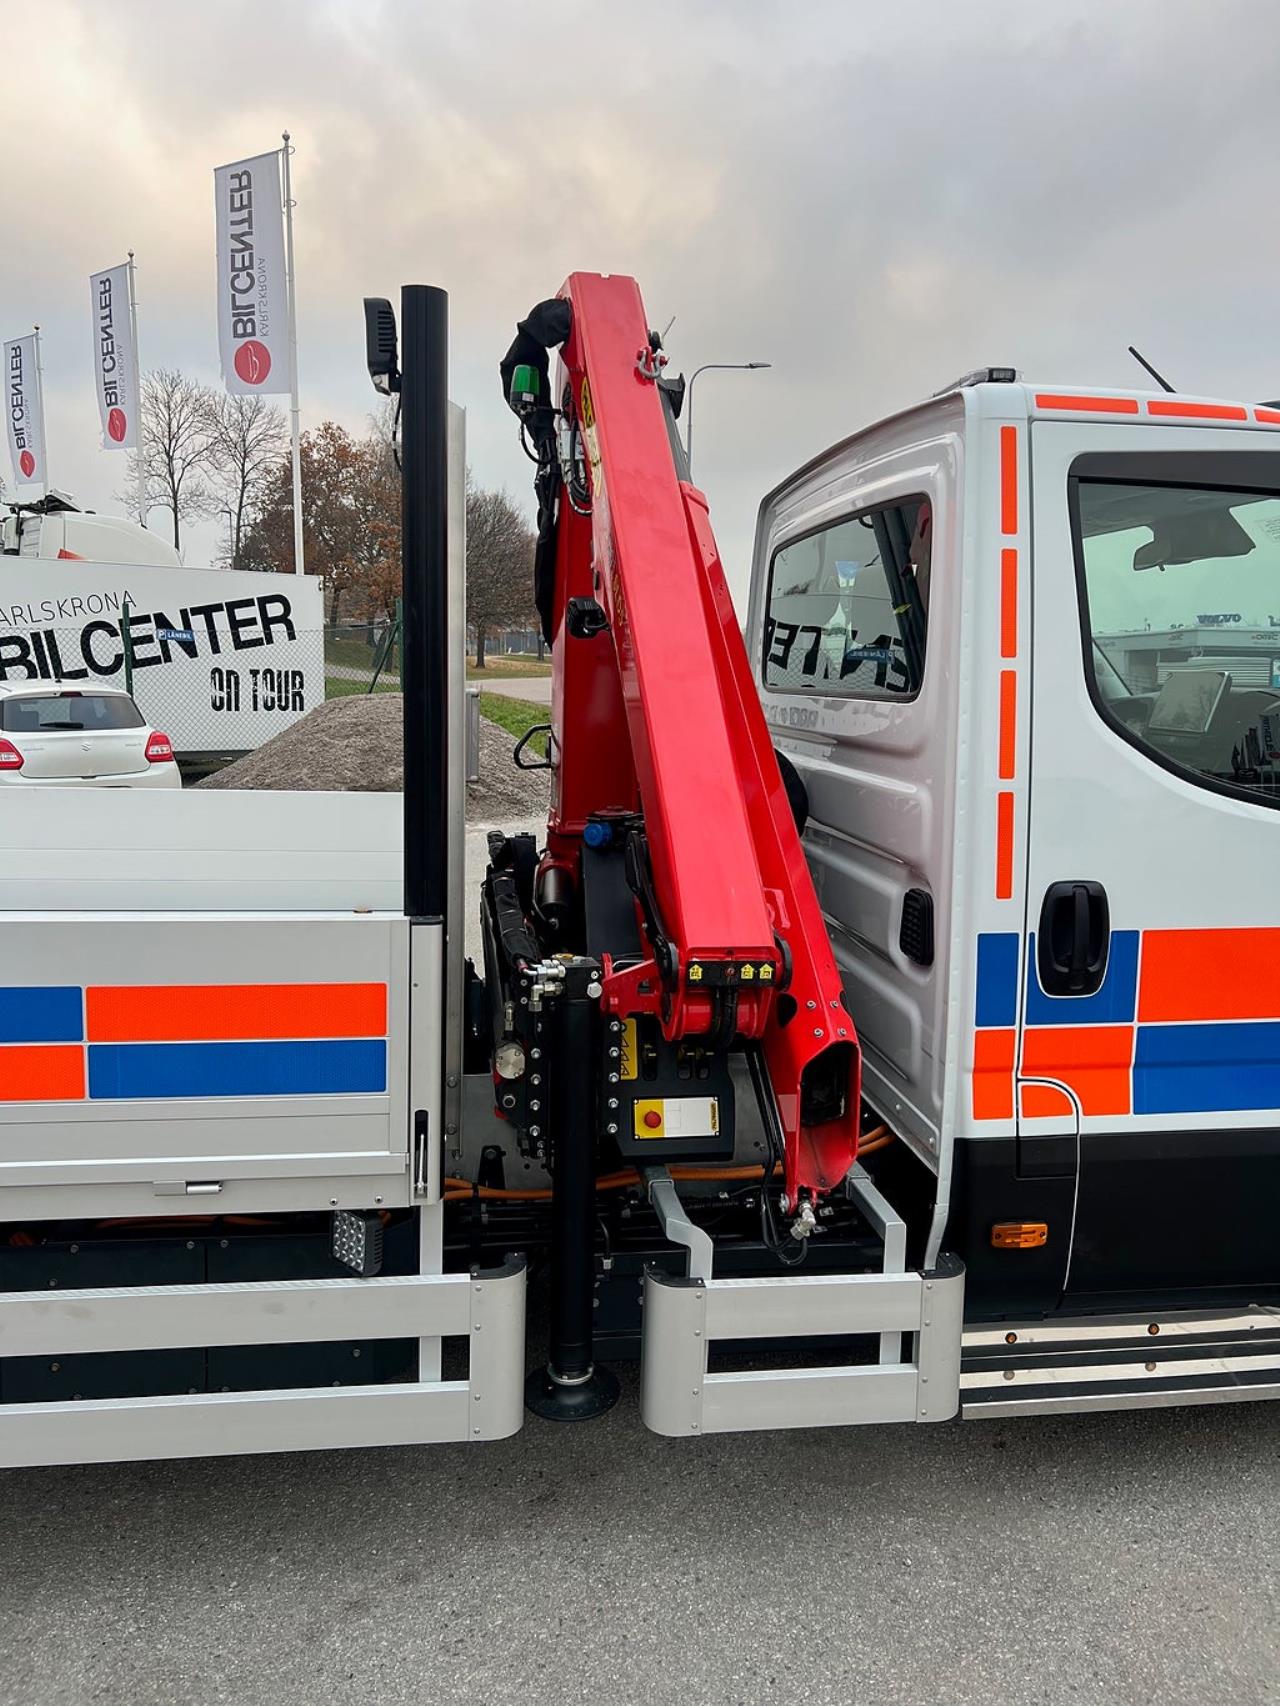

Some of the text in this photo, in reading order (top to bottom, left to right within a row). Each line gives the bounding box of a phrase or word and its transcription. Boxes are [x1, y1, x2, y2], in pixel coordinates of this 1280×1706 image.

[0, 590, 137, 627] ARLSKRONA
[1197, 614, 1242, 625] VOLVO
[0, 594, 297, 680] BILCENTER
[211, 667, 304, 711] ON TOUR
